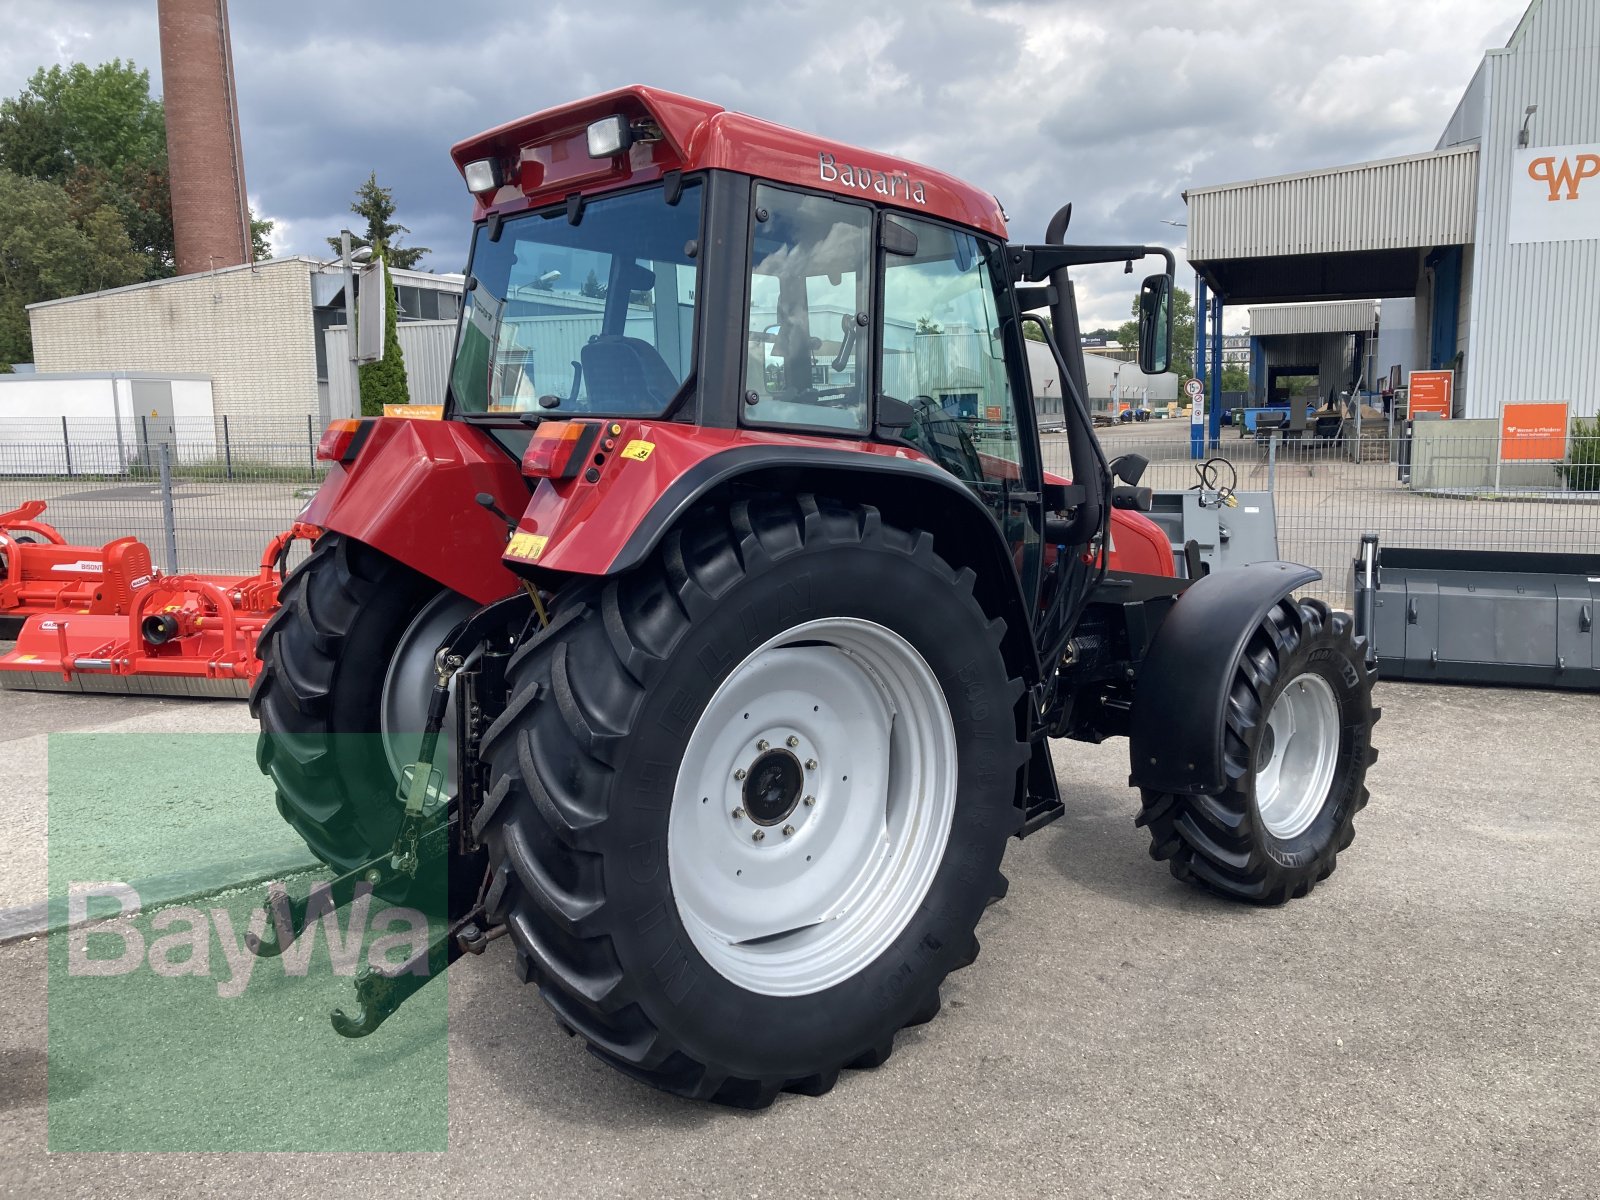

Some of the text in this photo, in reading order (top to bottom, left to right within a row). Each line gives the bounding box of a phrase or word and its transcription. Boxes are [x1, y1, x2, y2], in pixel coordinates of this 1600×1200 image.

[819, 152, 926, 204] Bavaria
[1189, 382, 1196, 393] 15
[627, 571, 816, 1008] MICHELIN
